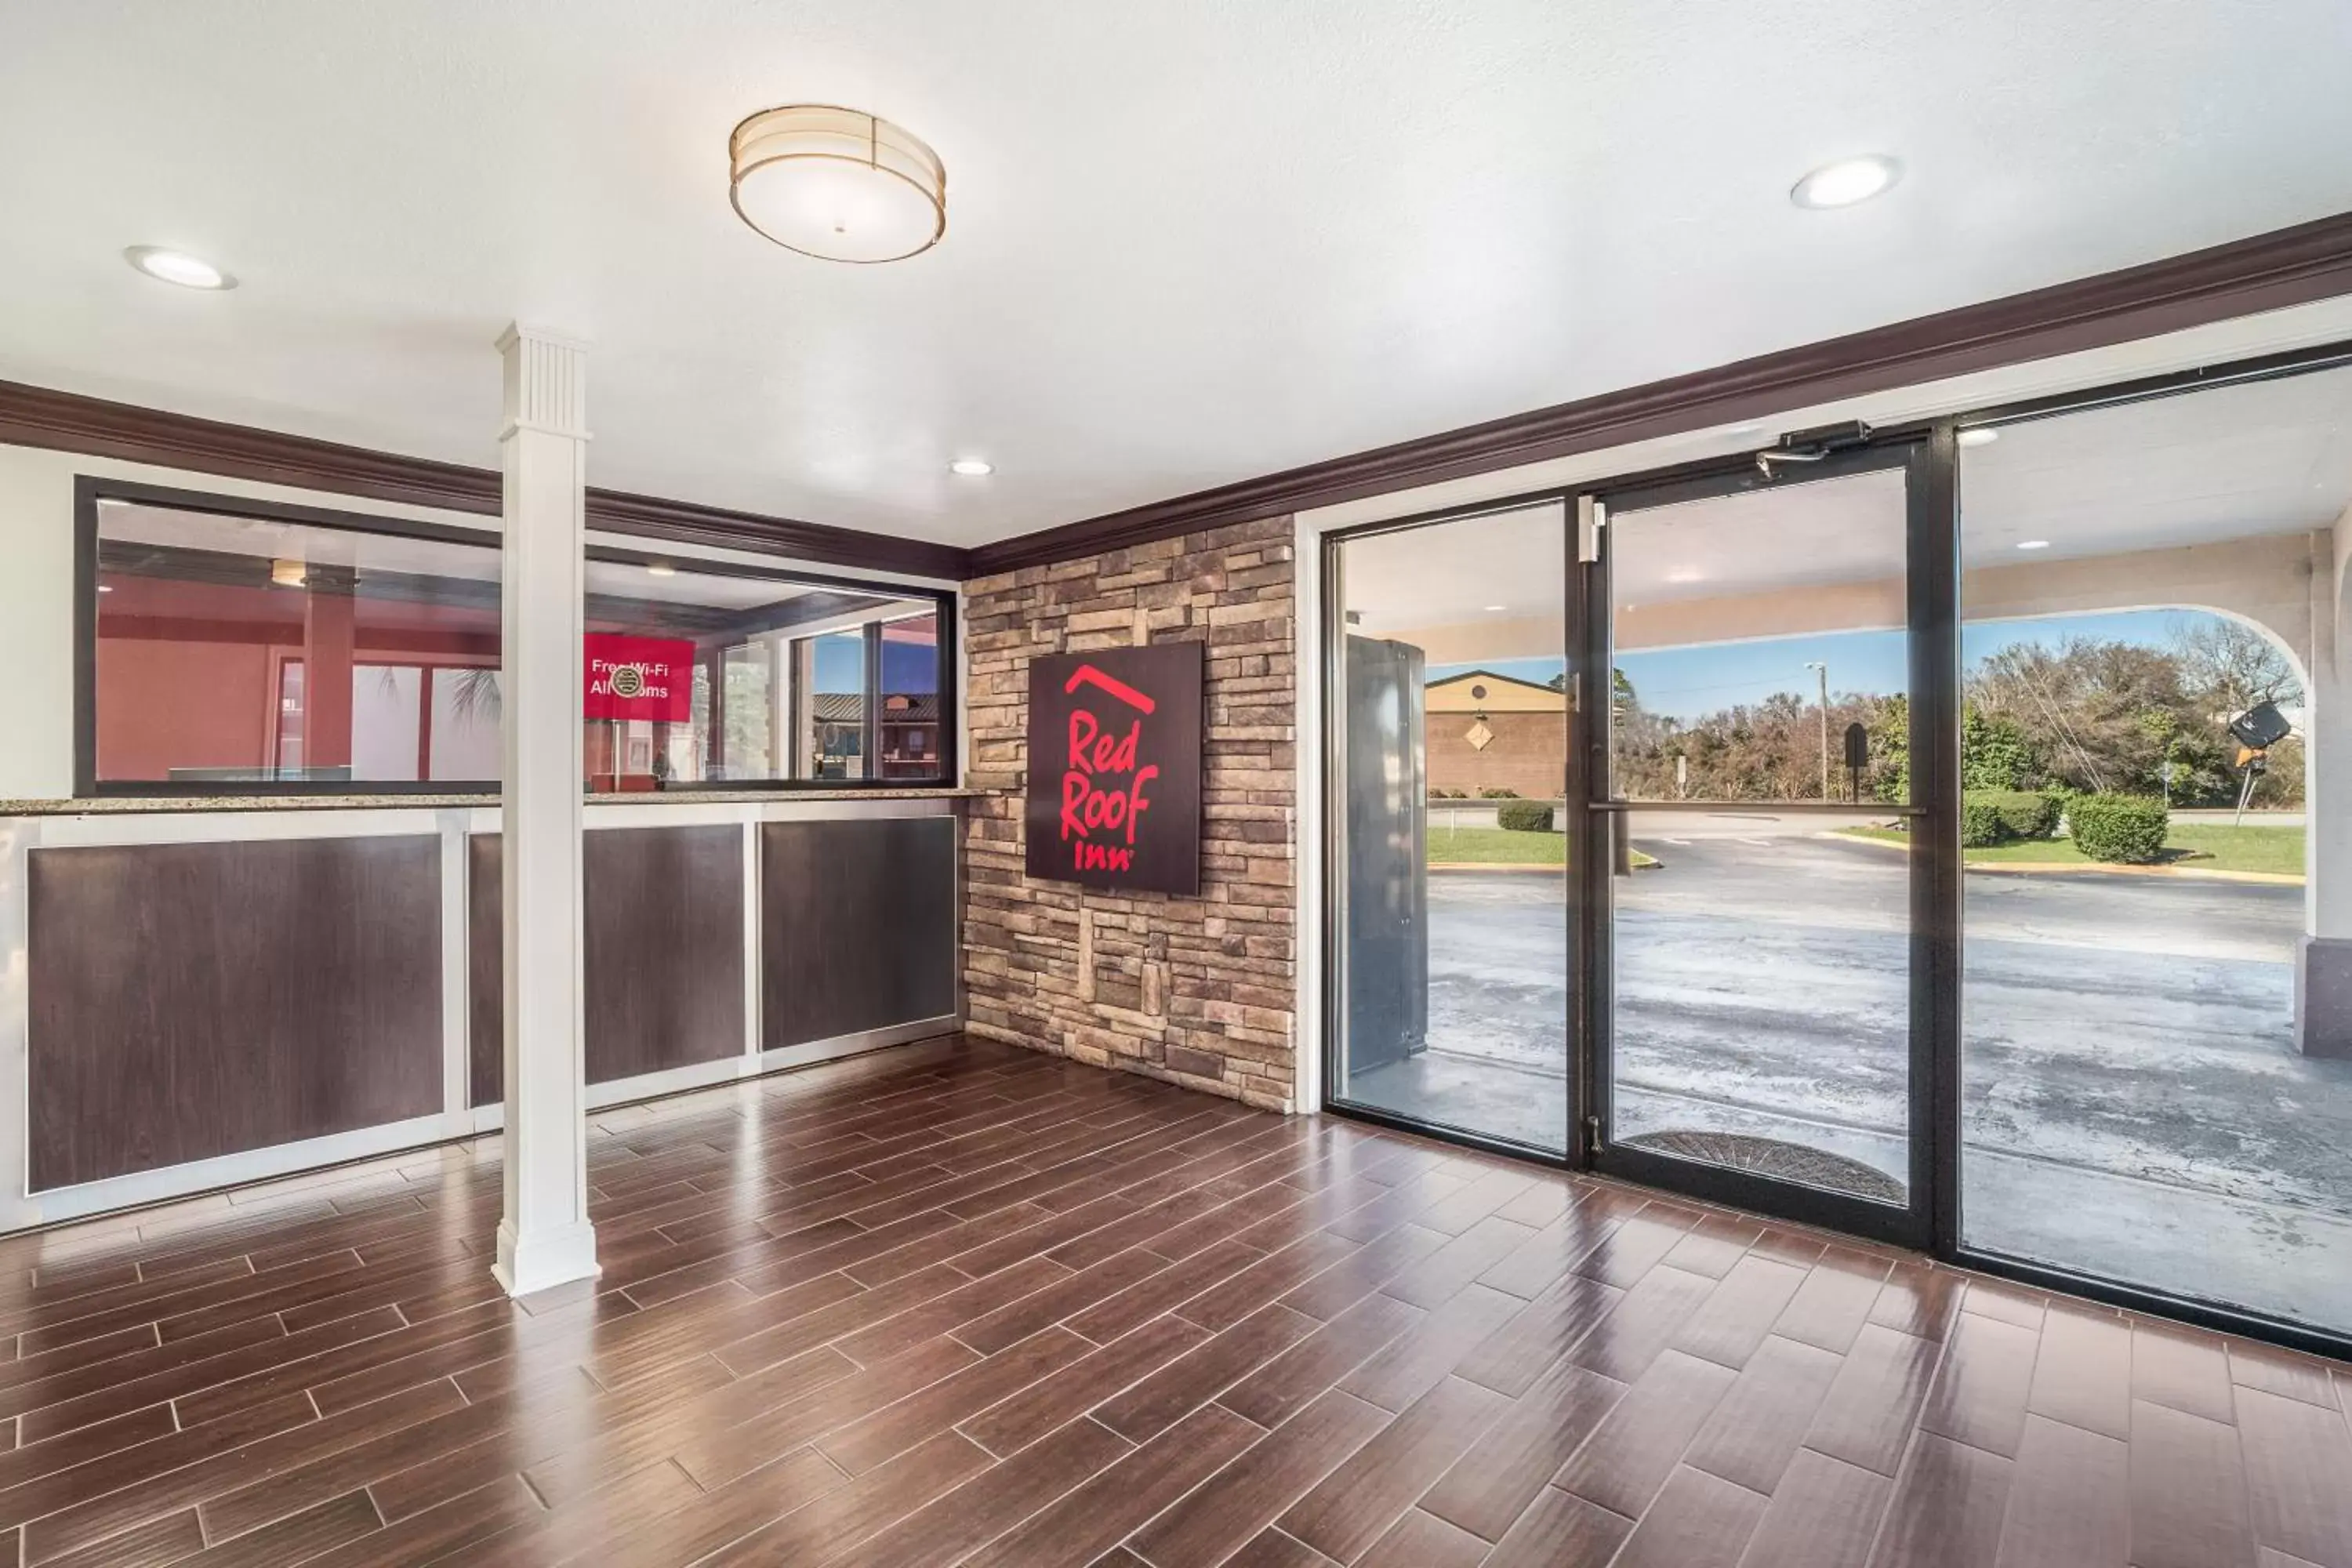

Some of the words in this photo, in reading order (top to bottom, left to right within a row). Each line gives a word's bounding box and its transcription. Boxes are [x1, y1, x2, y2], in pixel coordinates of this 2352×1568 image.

[590, 680, 611, 695] All
[1069, 710, 1141, 775] Red
[1060, 765, 1159, 844] Roof
[1075, 840, 1130, 872] Inn
